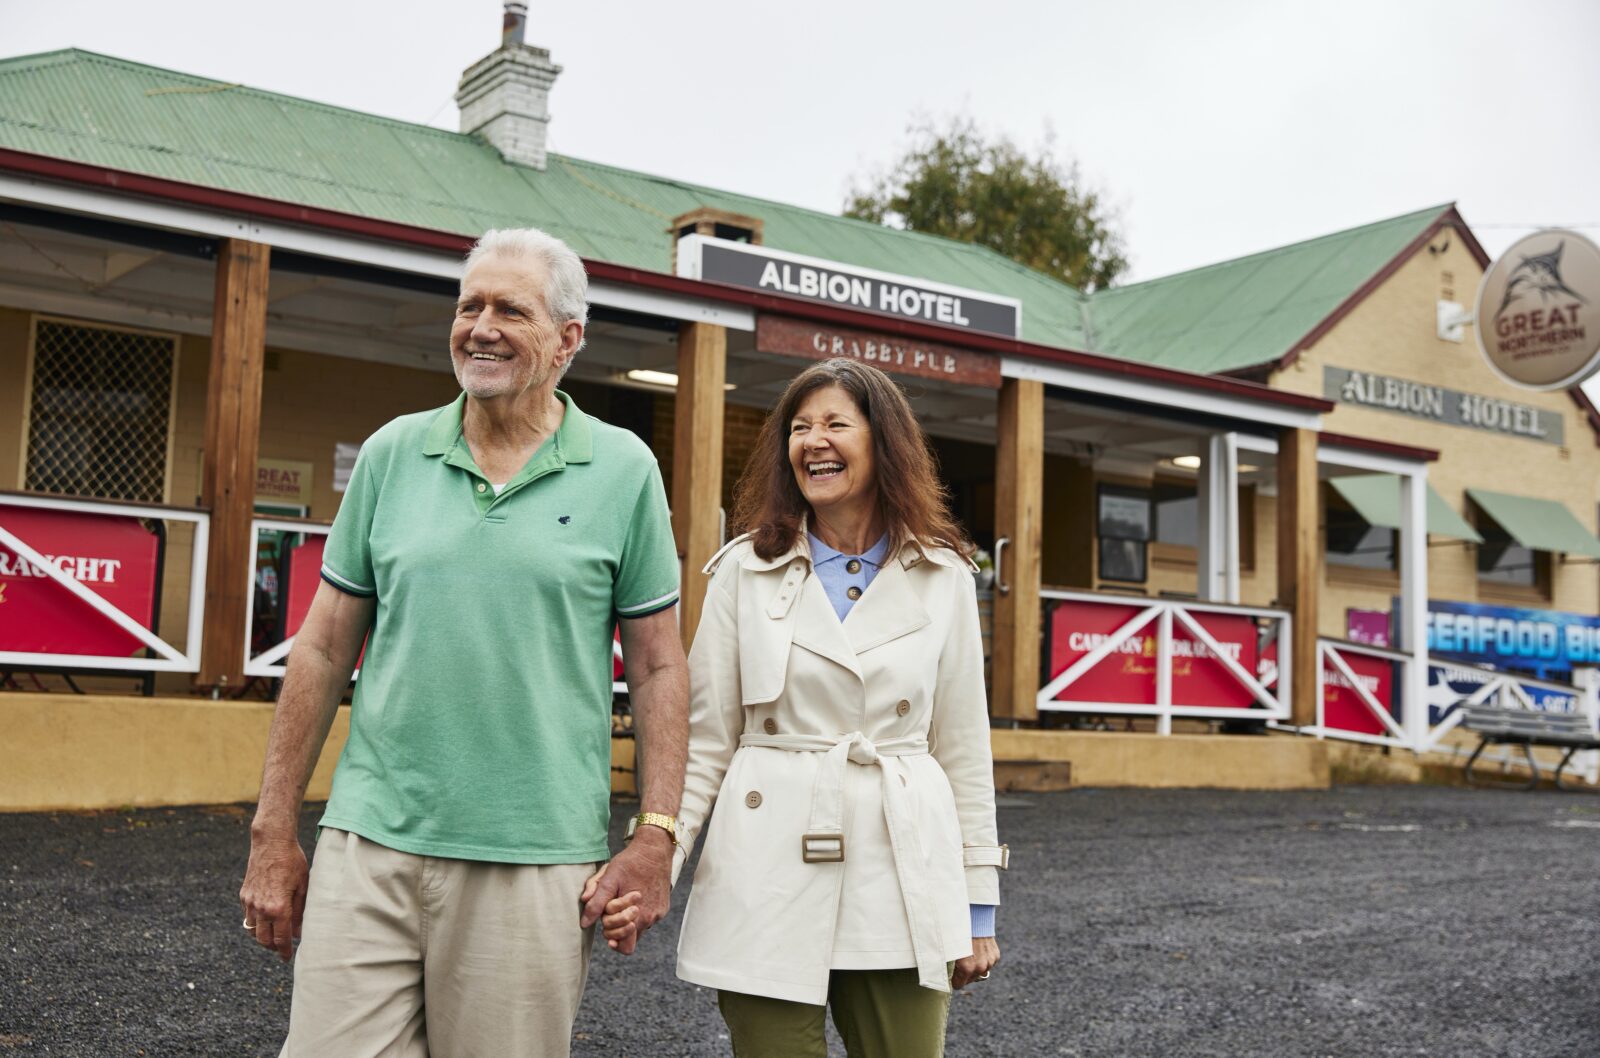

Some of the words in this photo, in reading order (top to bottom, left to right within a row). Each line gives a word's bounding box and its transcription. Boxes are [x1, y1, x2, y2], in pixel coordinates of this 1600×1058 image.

[759, 261, 872, 307] ALBION
[880, 284, 969, 326] HOTEL
[1495, 303, 1582, 338] GREAT
[1497, 325, 1585, 353] NORTHERN
[1342, 370, 1444, 417] ALBION
[1459, 394, 1548, 437] HOTEL
